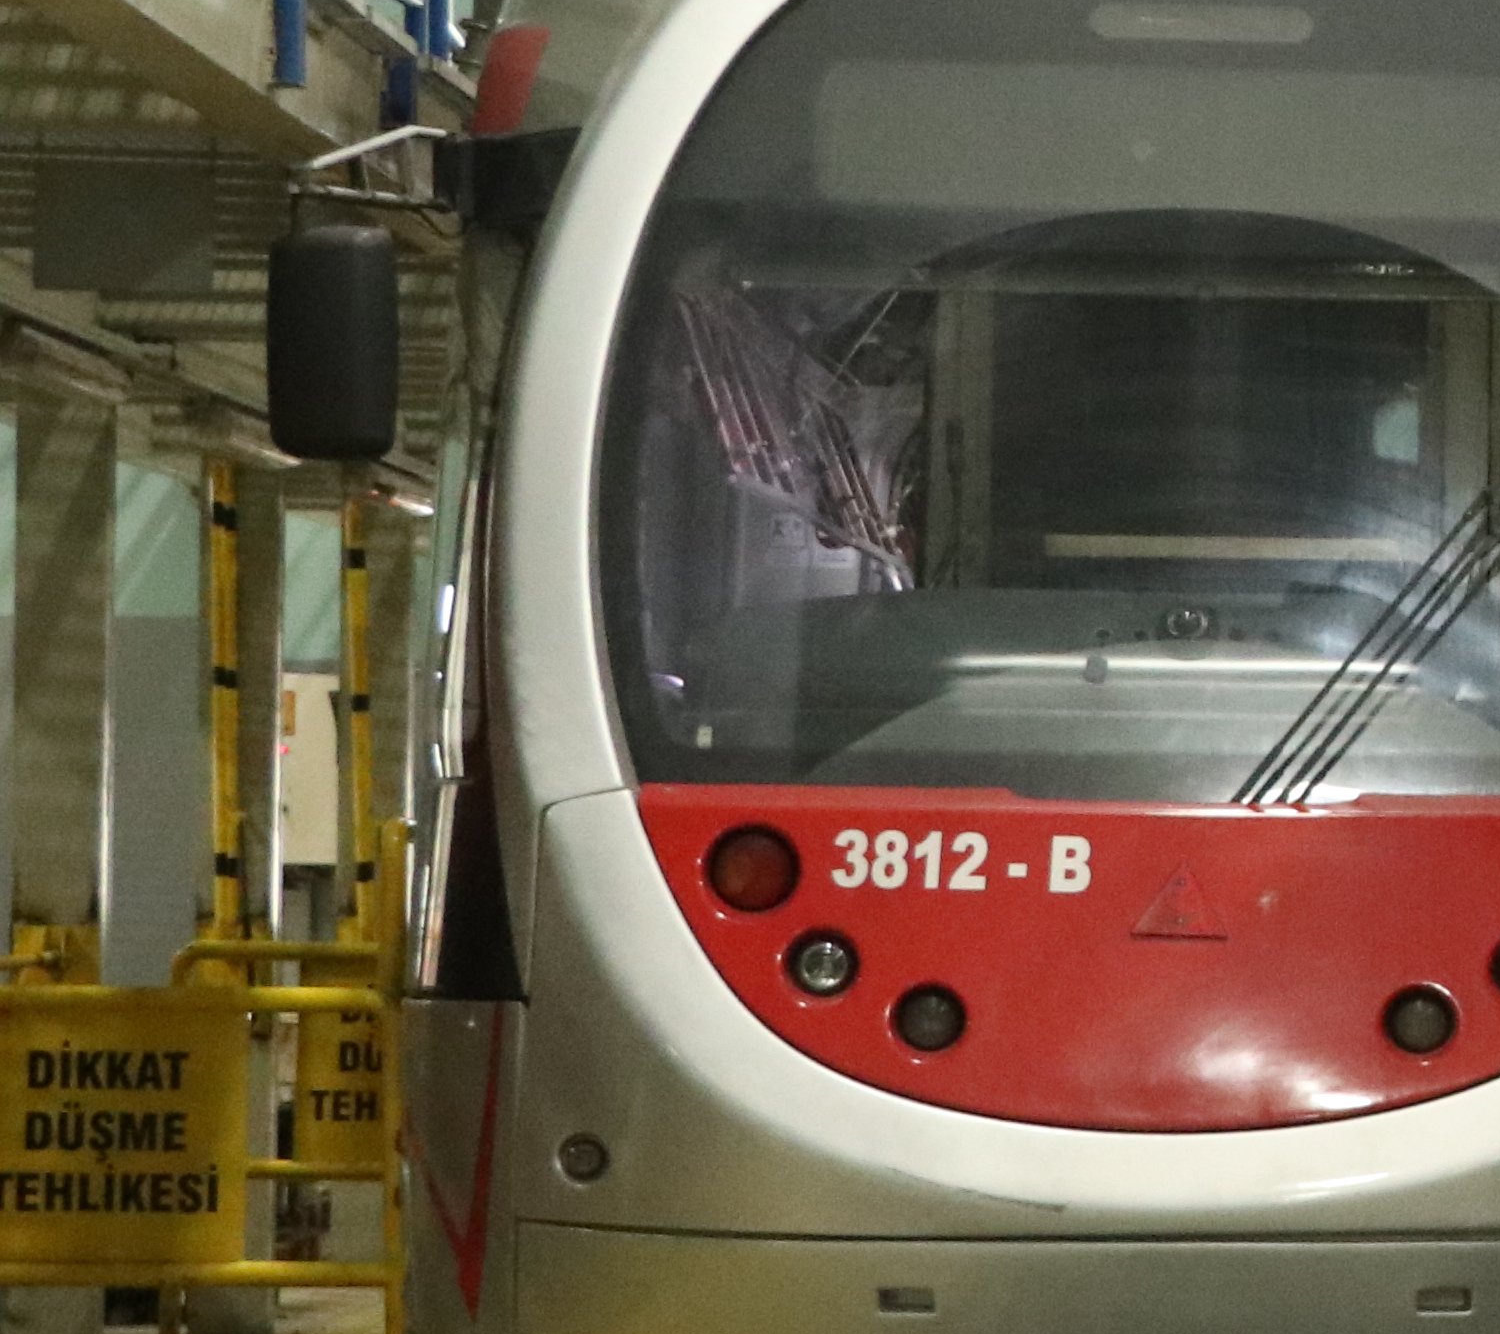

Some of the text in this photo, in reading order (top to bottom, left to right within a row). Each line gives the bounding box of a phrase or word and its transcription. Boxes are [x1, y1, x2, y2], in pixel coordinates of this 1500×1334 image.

[831, 829, 988, 891] 3812
[1049, 835, 1092, 893] B
[26, 1039, 190, 1090] DİKKAT
[24, 1101, 188, 1163] DÜŞME
